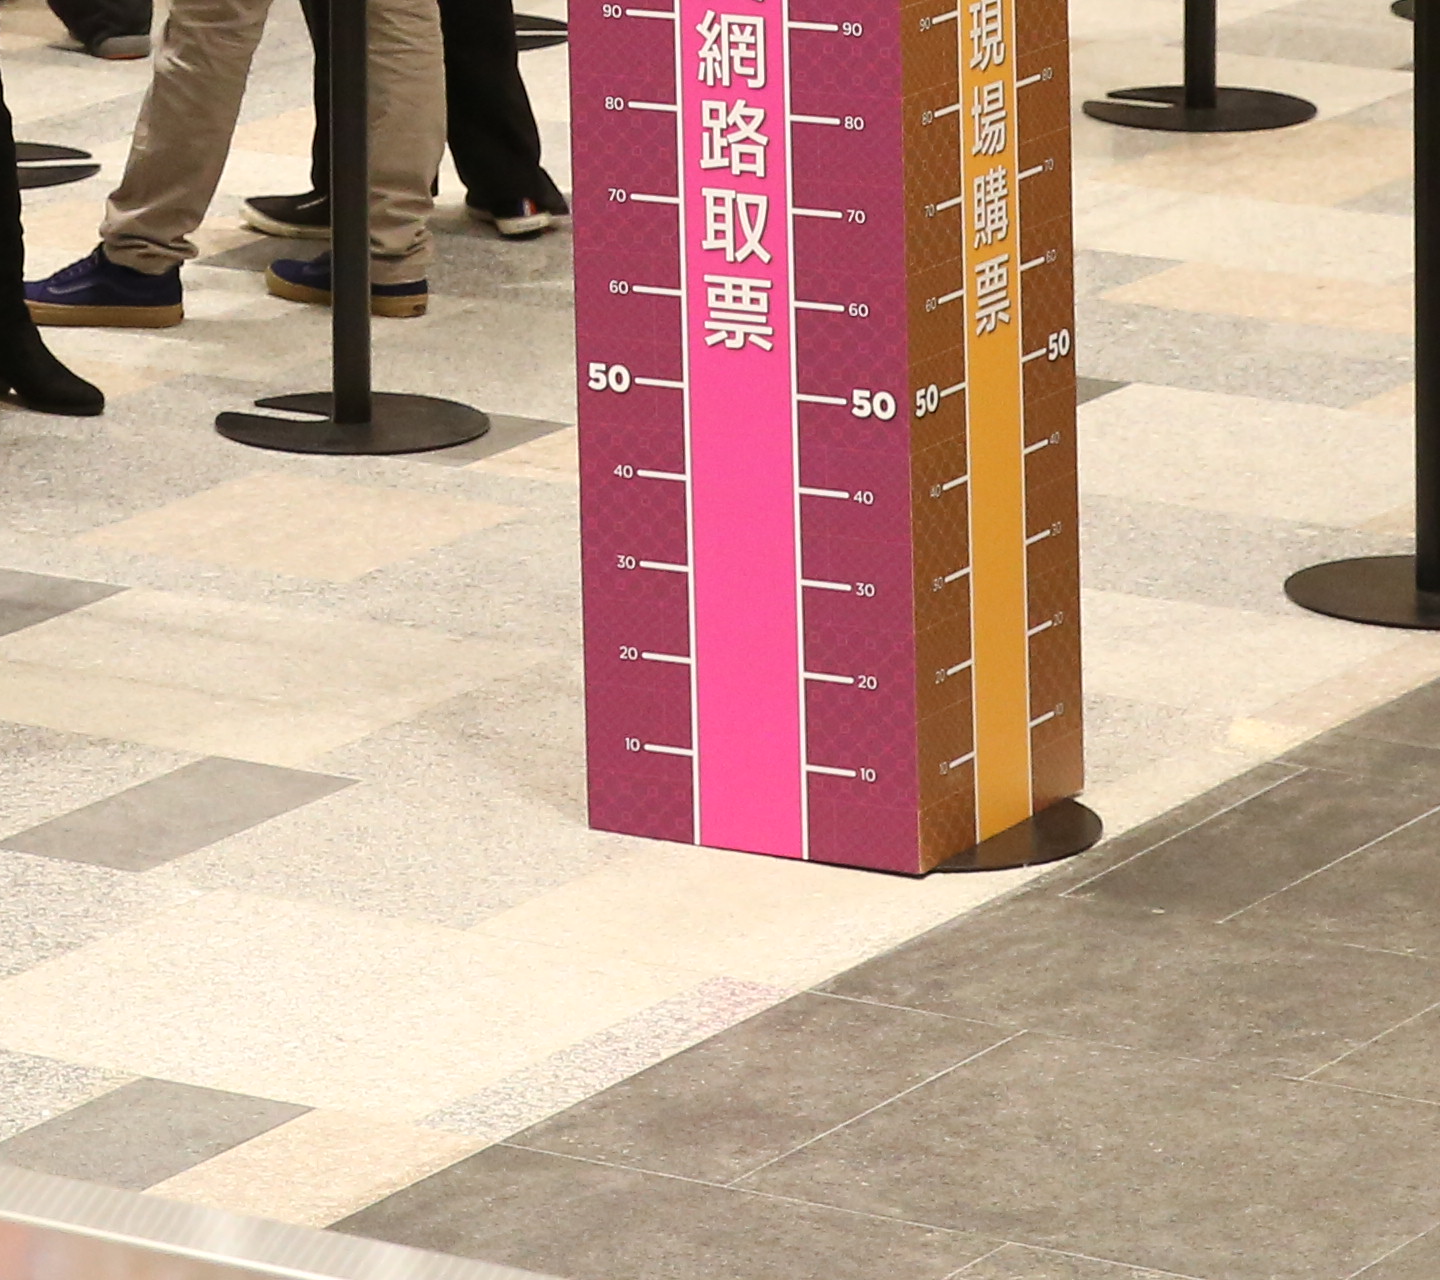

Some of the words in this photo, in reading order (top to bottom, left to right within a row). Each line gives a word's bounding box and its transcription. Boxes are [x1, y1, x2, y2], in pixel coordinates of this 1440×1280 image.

[602, 4, 622, 20] 90
[842, 21, 863, 38] 90
[604, 96, 625, 112] 80
[844, 115, 865, 132] 80
[607, 188, 627, 204] 70
[846, 208, 867, 225] 70
[608, 280, 629, 296] 60
[848, 302, 870, 319] 60
[1047, 328, 1070, 362] 50
[587, 363, 632, 394] 50
[851, 388, 897, 422] 50
[914, 384, 939, 418] 50
[613, 463, 634, 480] 40
[852, 488, 875, 506] 40
[616, 554, 636, 571] 30
[855, 581, 876, 598] 30
[618, 645, 639, 662] 20
[857, 673, 878, 691] 20
[624, 737, 641, 753] 10
[859, 766, 877, 783] 10
